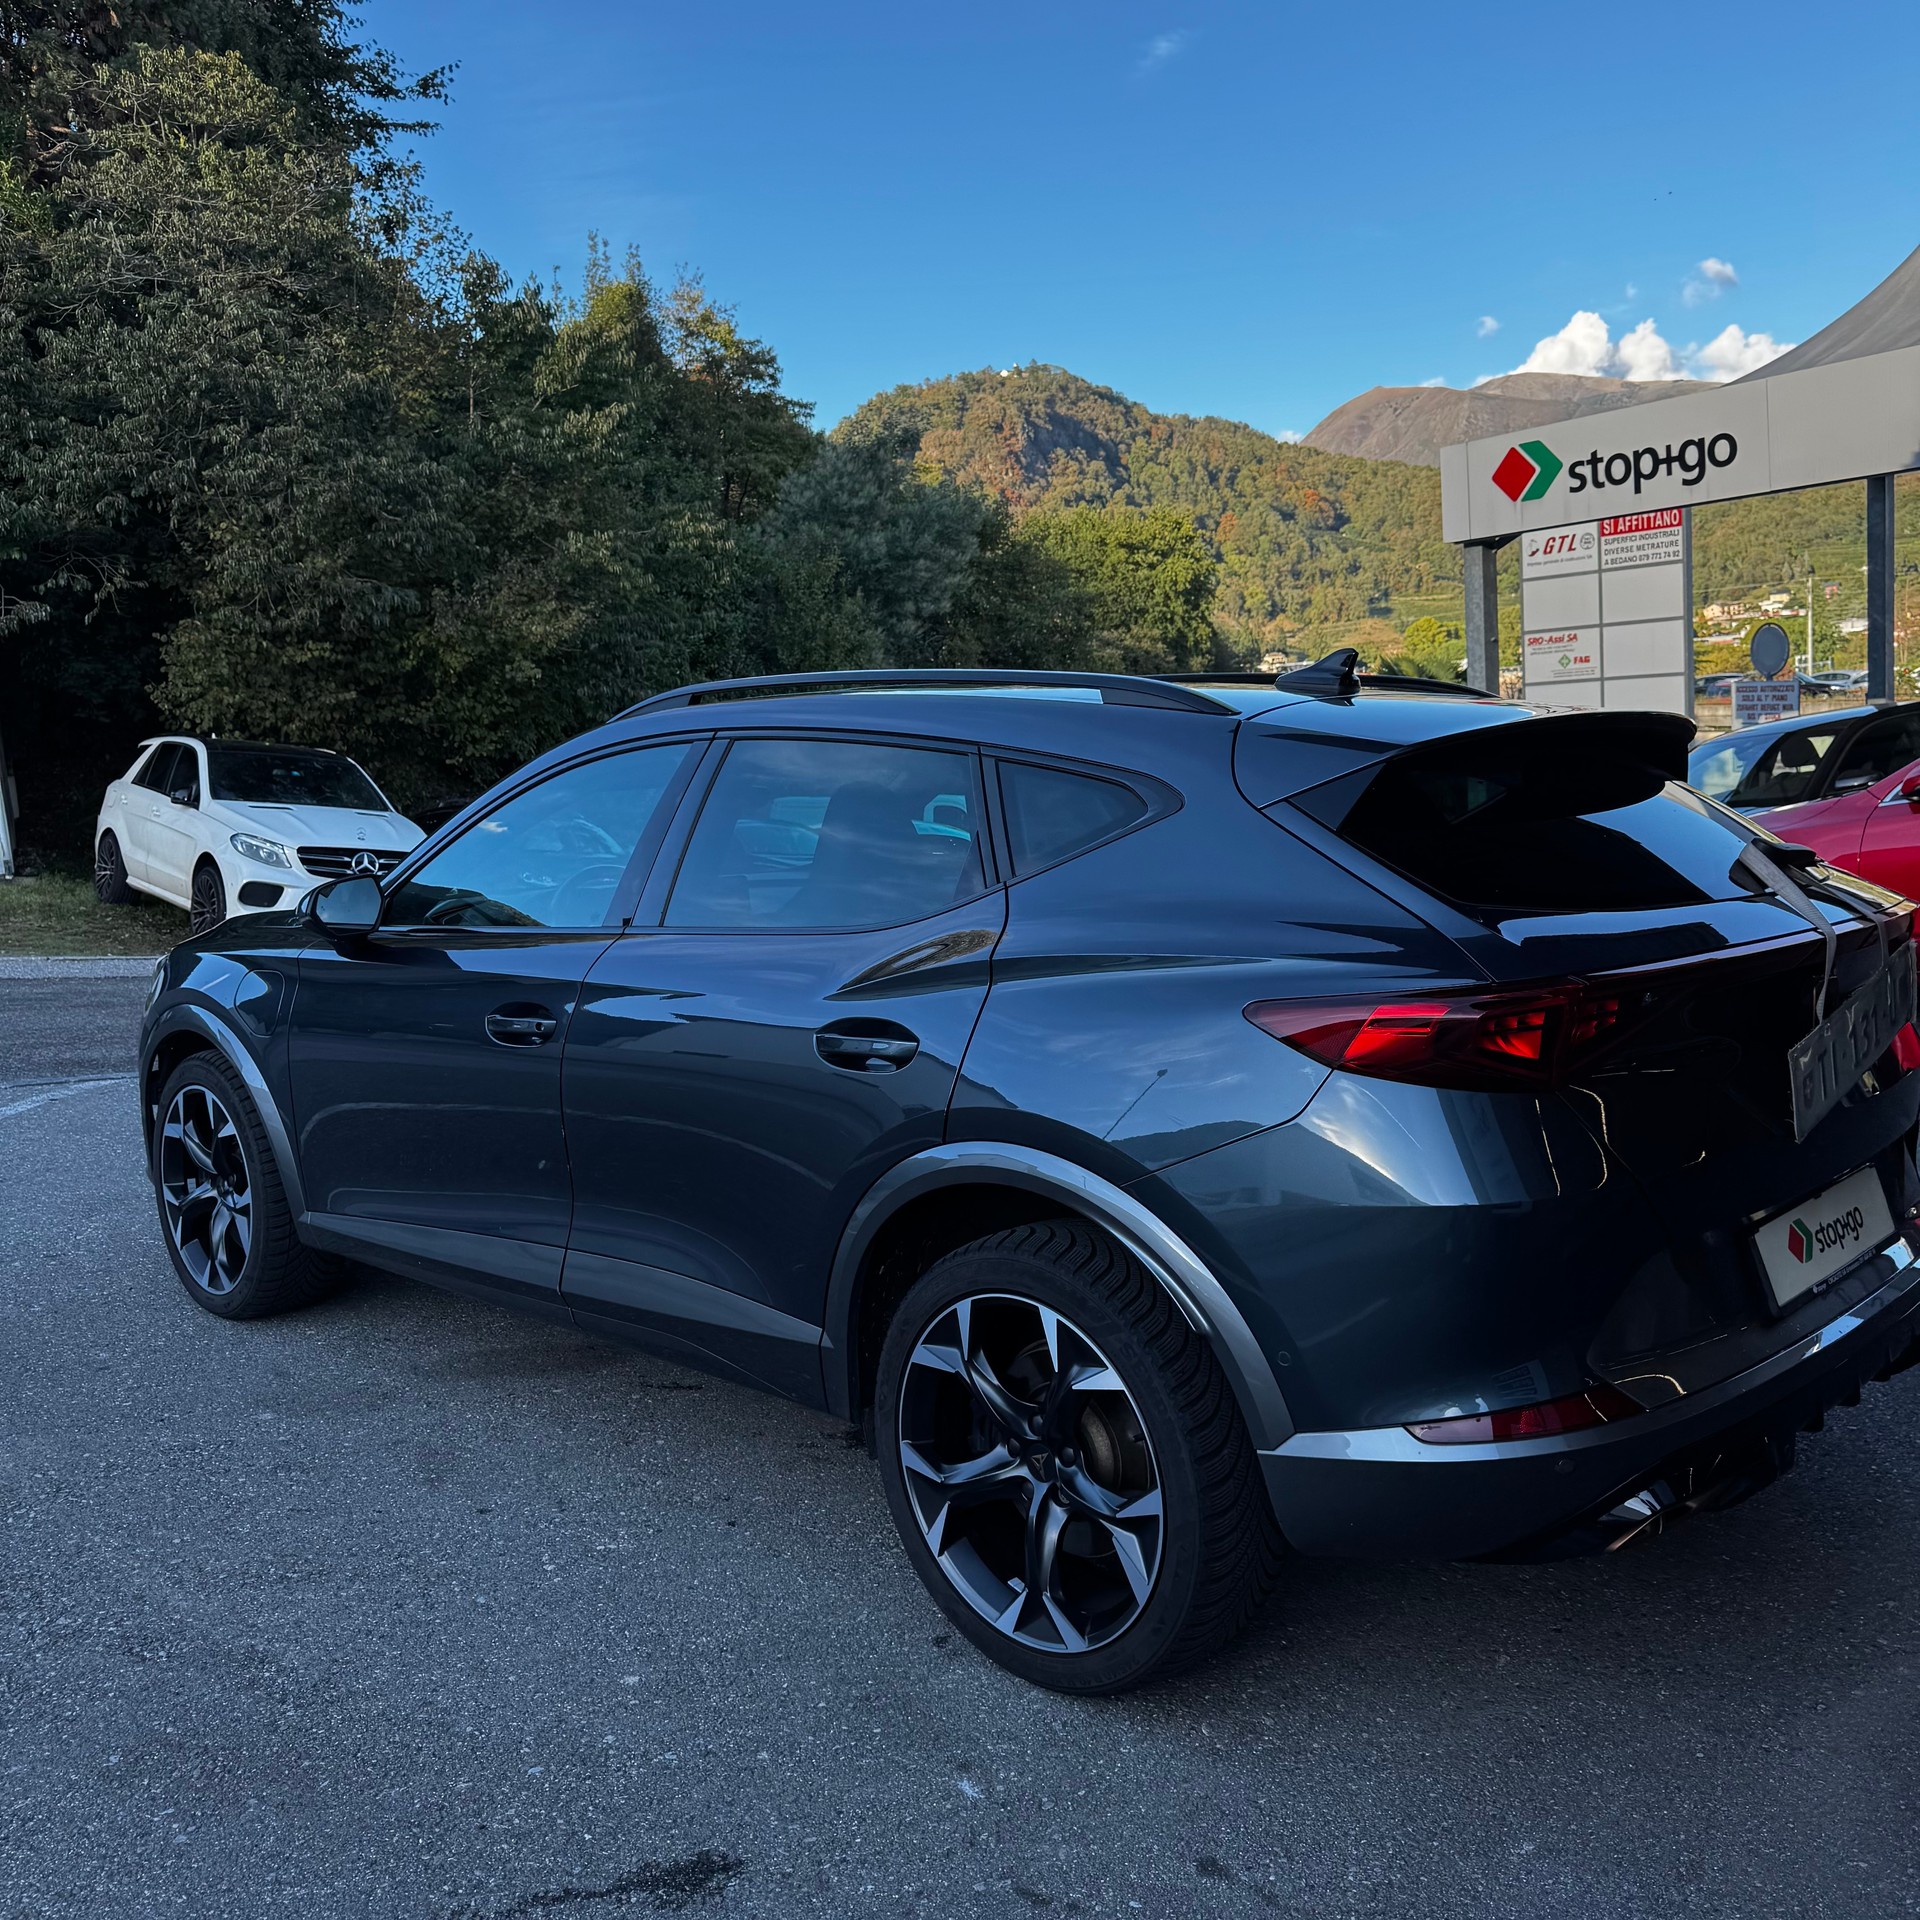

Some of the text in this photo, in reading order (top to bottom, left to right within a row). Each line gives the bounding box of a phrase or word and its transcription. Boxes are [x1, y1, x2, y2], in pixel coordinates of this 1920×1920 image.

[1568, 433, 1738, 494] stop+go
[1603, 509, 1680, 535] SI AFFITTANO
[1543, 533, 1577, 555] GTL
[1604, 535, 1637, 546] SUPERFICI
[1638, 528, 1680, 541] INDUSTRIALI
[1604, 539, 1680, 556] DIVERSE METRATURE
[1603, 558, 1609, 566] A
[1610, 555, 1638, 565] BEDANO
[1639, 553, 1650, 562] 079
[1651, 552, 1662, 560] 771
[1567, 632, 1578, 643] SA
[1815, 1206, 1864, 1253] stop+go
